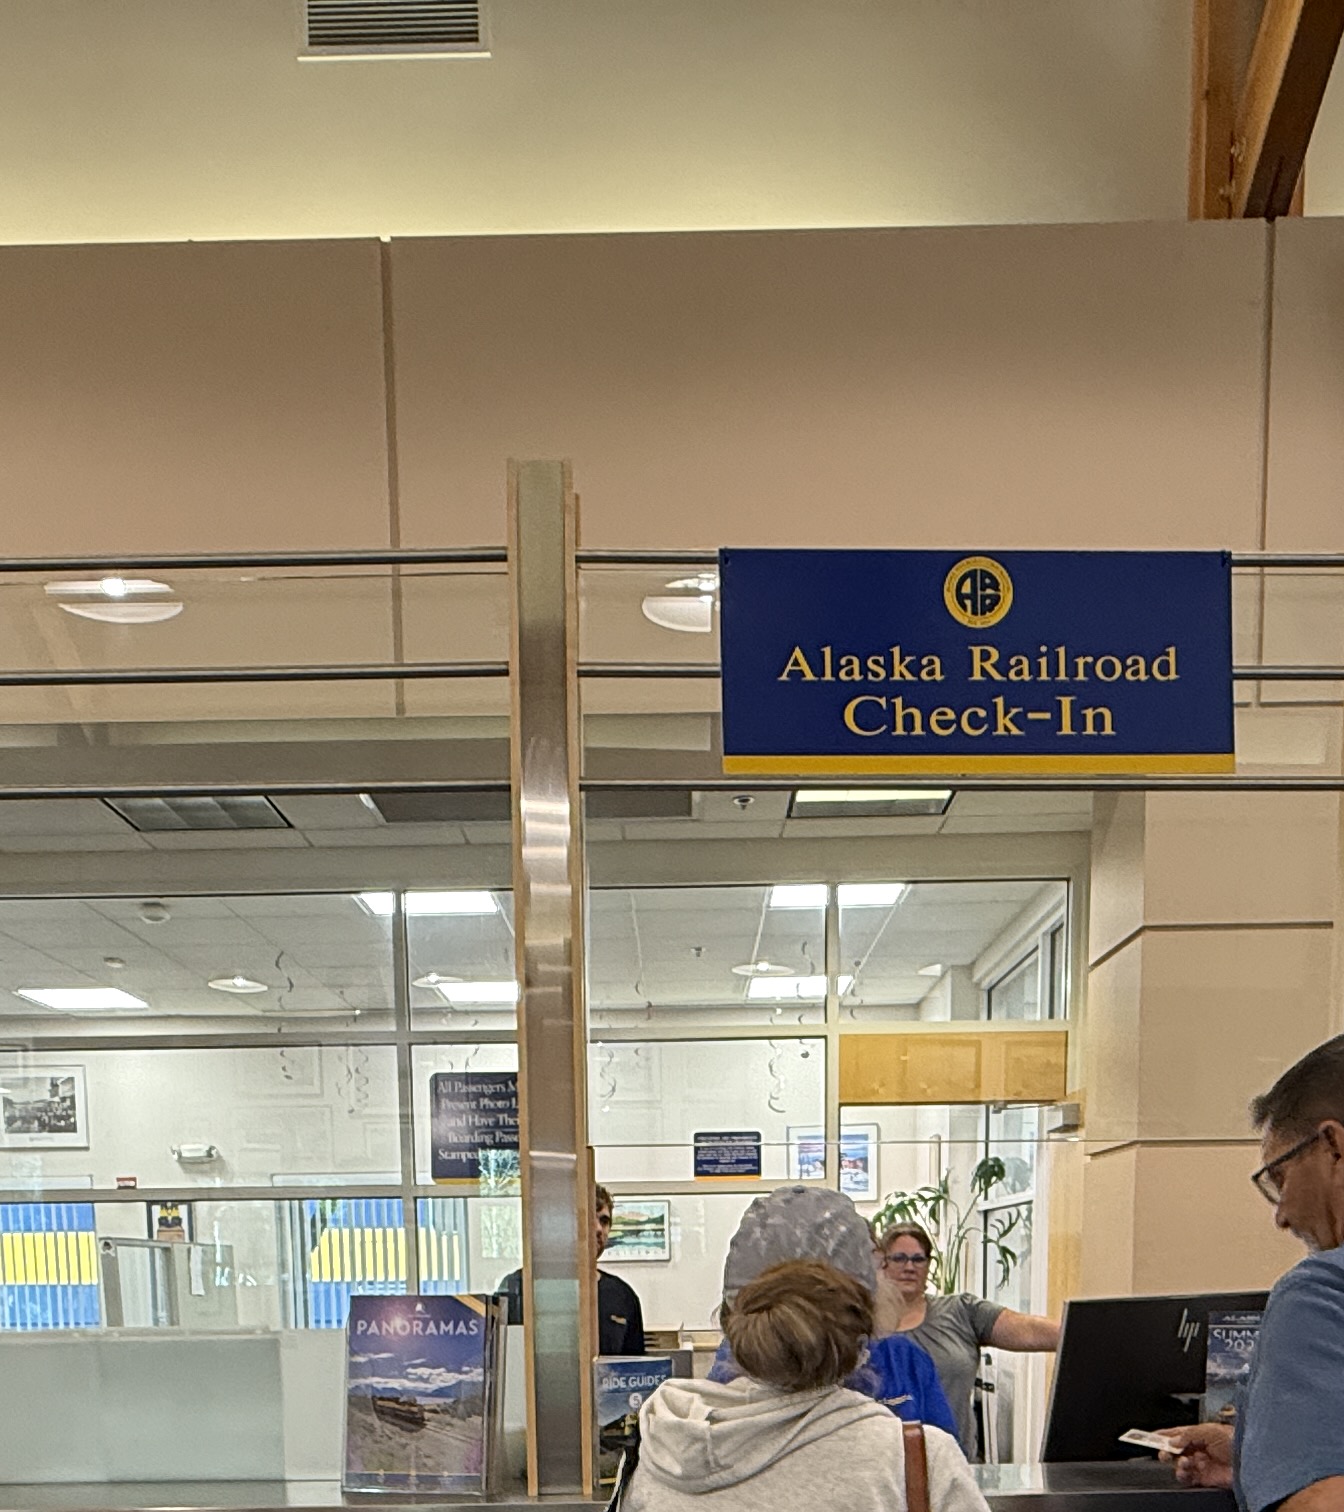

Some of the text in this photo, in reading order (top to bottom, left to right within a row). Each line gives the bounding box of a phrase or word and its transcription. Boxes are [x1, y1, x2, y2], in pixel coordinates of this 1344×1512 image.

[777, 645, 1181, 683] Alaska Railroad
[843, 695, 1118, 738] Check-In
[437, 1081, 452, 1094] All
[454, 1081, 506, 1096] Passengers
[440, 1097, 477, 1110] Present
[479, 1097, 510, 1110] Photo
[356, 1318, 479, 1337] PANORAMAS
[1213, 1328, 1260, 1341] SUMM
[1224, 1339, 1255, 1352] 202
[601, 1376, 627, 1390] RIDE
